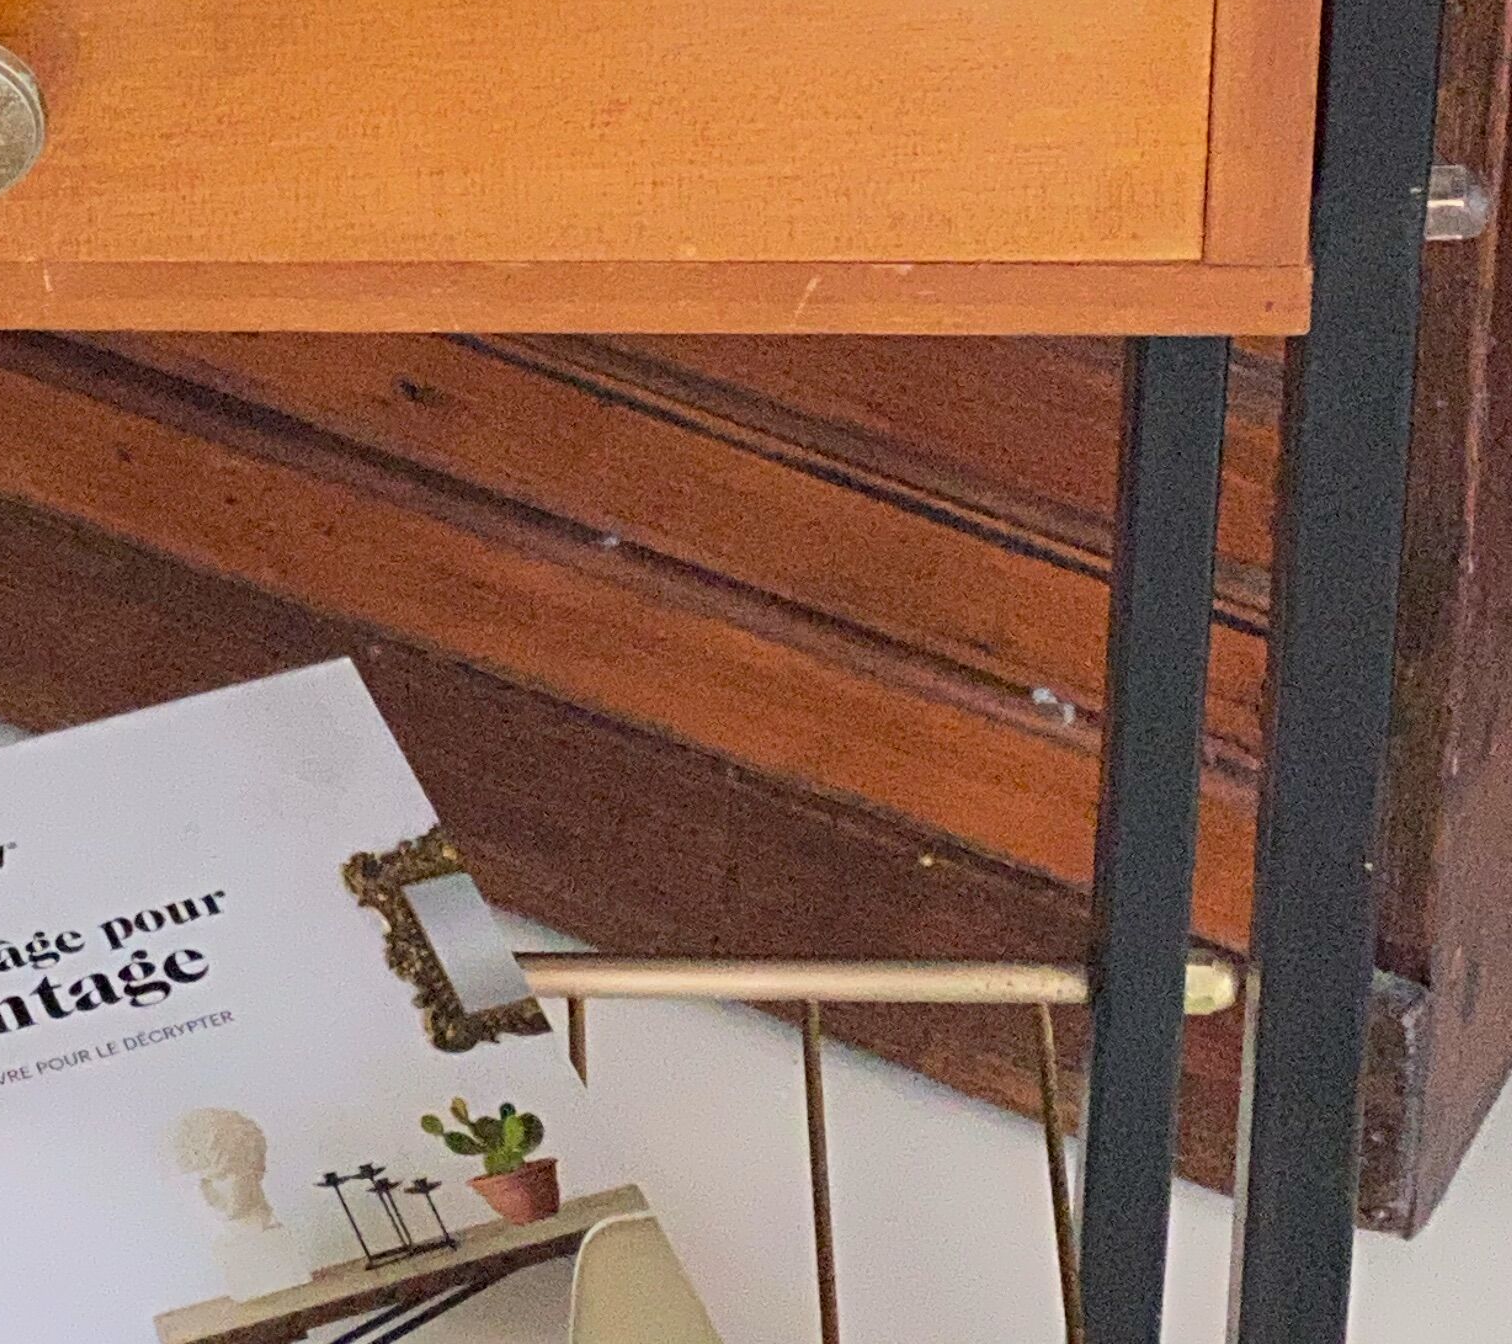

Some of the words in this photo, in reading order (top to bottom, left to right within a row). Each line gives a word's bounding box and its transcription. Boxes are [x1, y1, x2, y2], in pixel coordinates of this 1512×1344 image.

[98, 889, 227, 951] pour
[35, 1049, 92, 1075] POUR
[95, 1040, 120, 1058] LE
